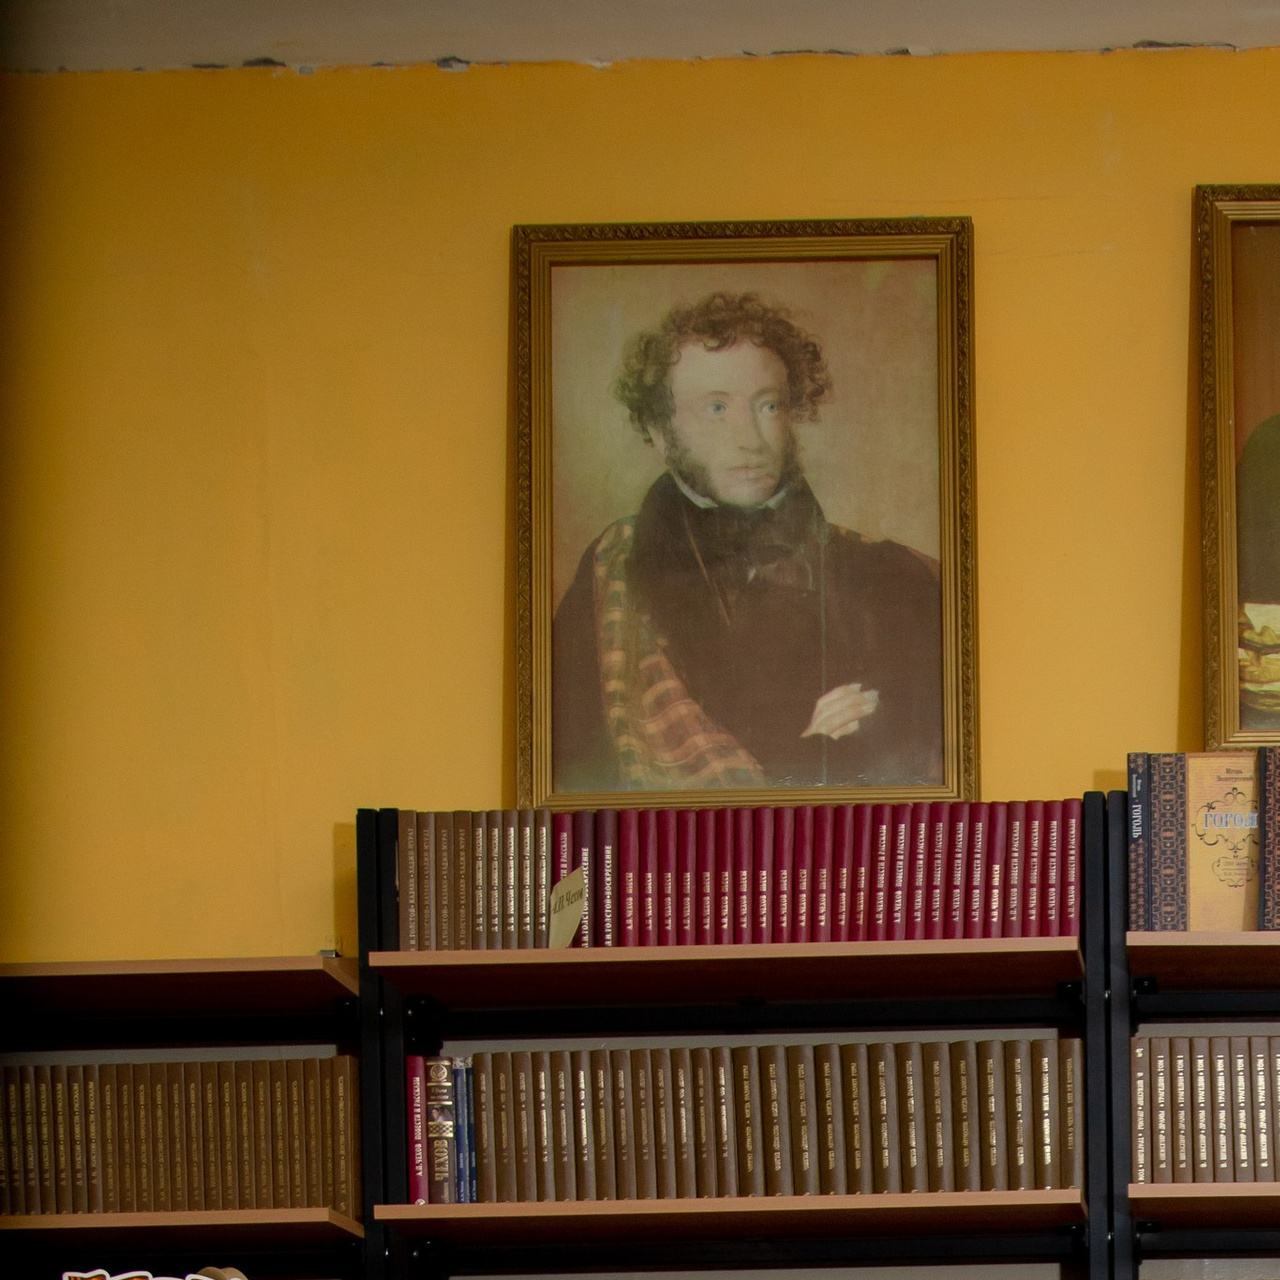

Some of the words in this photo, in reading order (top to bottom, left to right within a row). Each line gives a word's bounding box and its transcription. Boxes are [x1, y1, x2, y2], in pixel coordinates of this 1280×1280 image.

[1132, 804, 1142, 838] ГОГОЛЬ
[1204, 812, 1258, 828] ГОГОЛ
[604, 844, 612, 896] ВОСКРЕСЕНИЕ
[414, 1114, 422, 1140] ПОВЕСТИ
[415, 1144, 423, 1176] А.П.ЧЕХОВ
[434, 1140, 449, 1181] ЧЕХОВ
